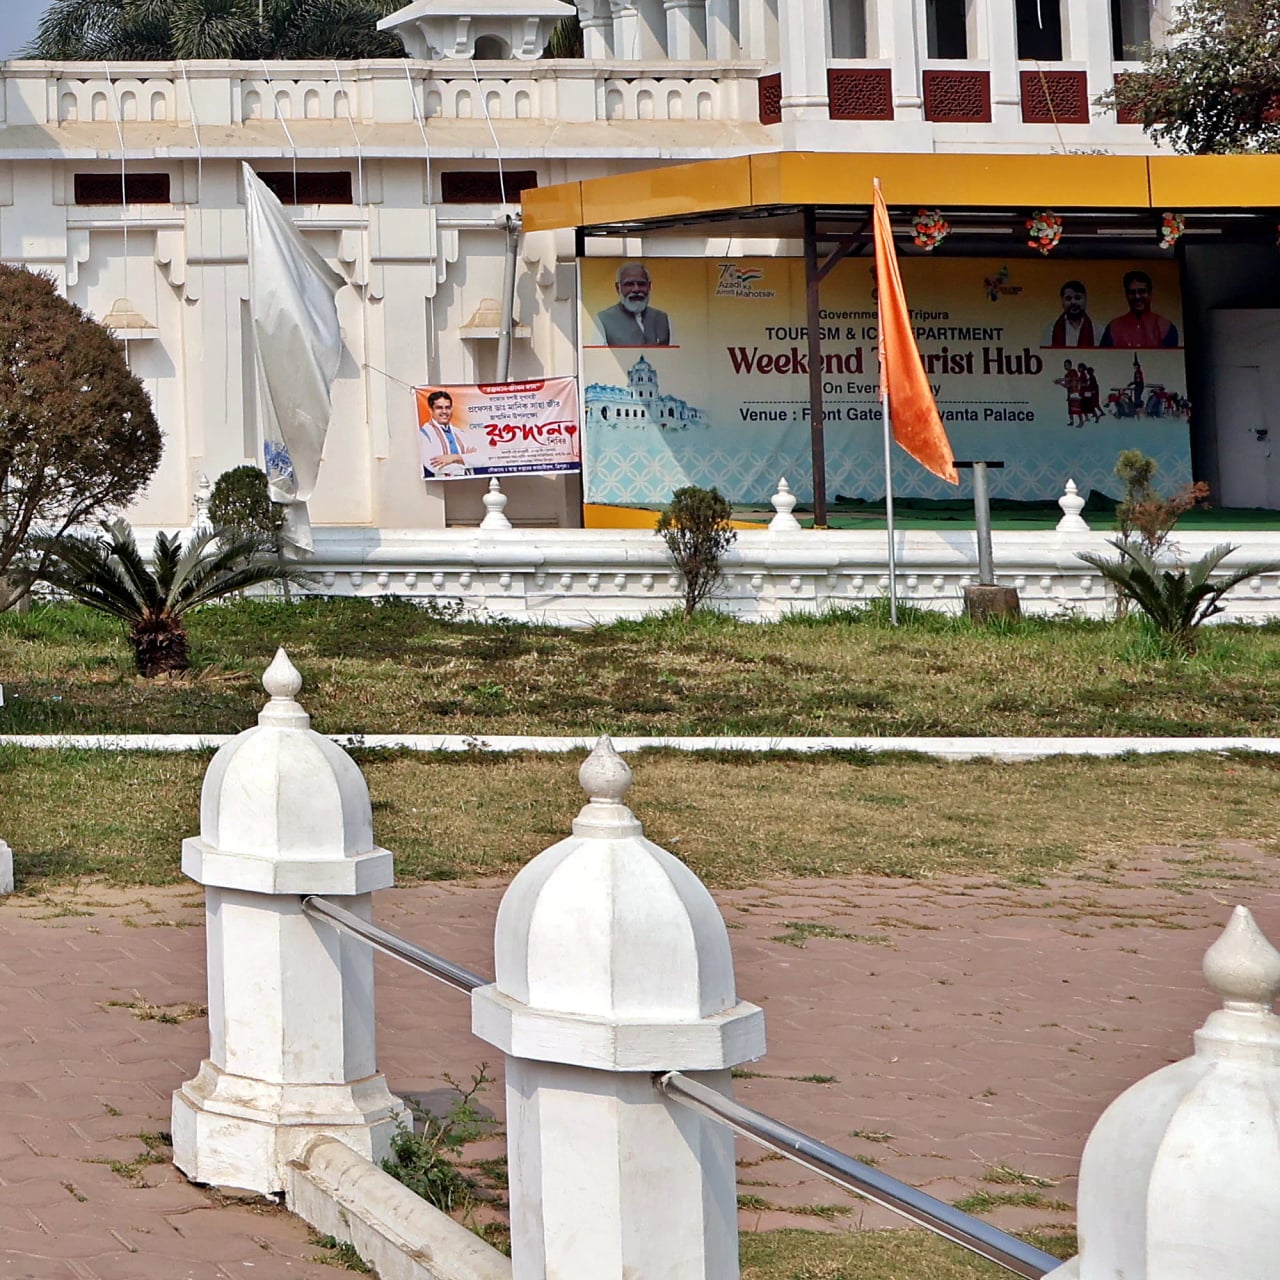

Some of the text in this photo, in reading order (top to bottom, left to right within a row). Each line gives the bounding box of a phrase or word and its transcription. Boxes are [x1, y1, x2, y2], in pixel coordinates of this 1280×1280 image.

[719, 280, 742, 289] Azadi
[735, 290, 776, 298] Mahotsav
[765, 327, 840, 340] TOURSM
[845, 327, 857, 340] &
[983, 347, 1043, 375] Hub
[823, 382, 881, 394] On Ever
[740, 408, 787, 421] Venue
[846, 408, 883, 421] Gate
[984, 408, 1034, 422] Palace
[547, 436, 566, 446] শিবির
